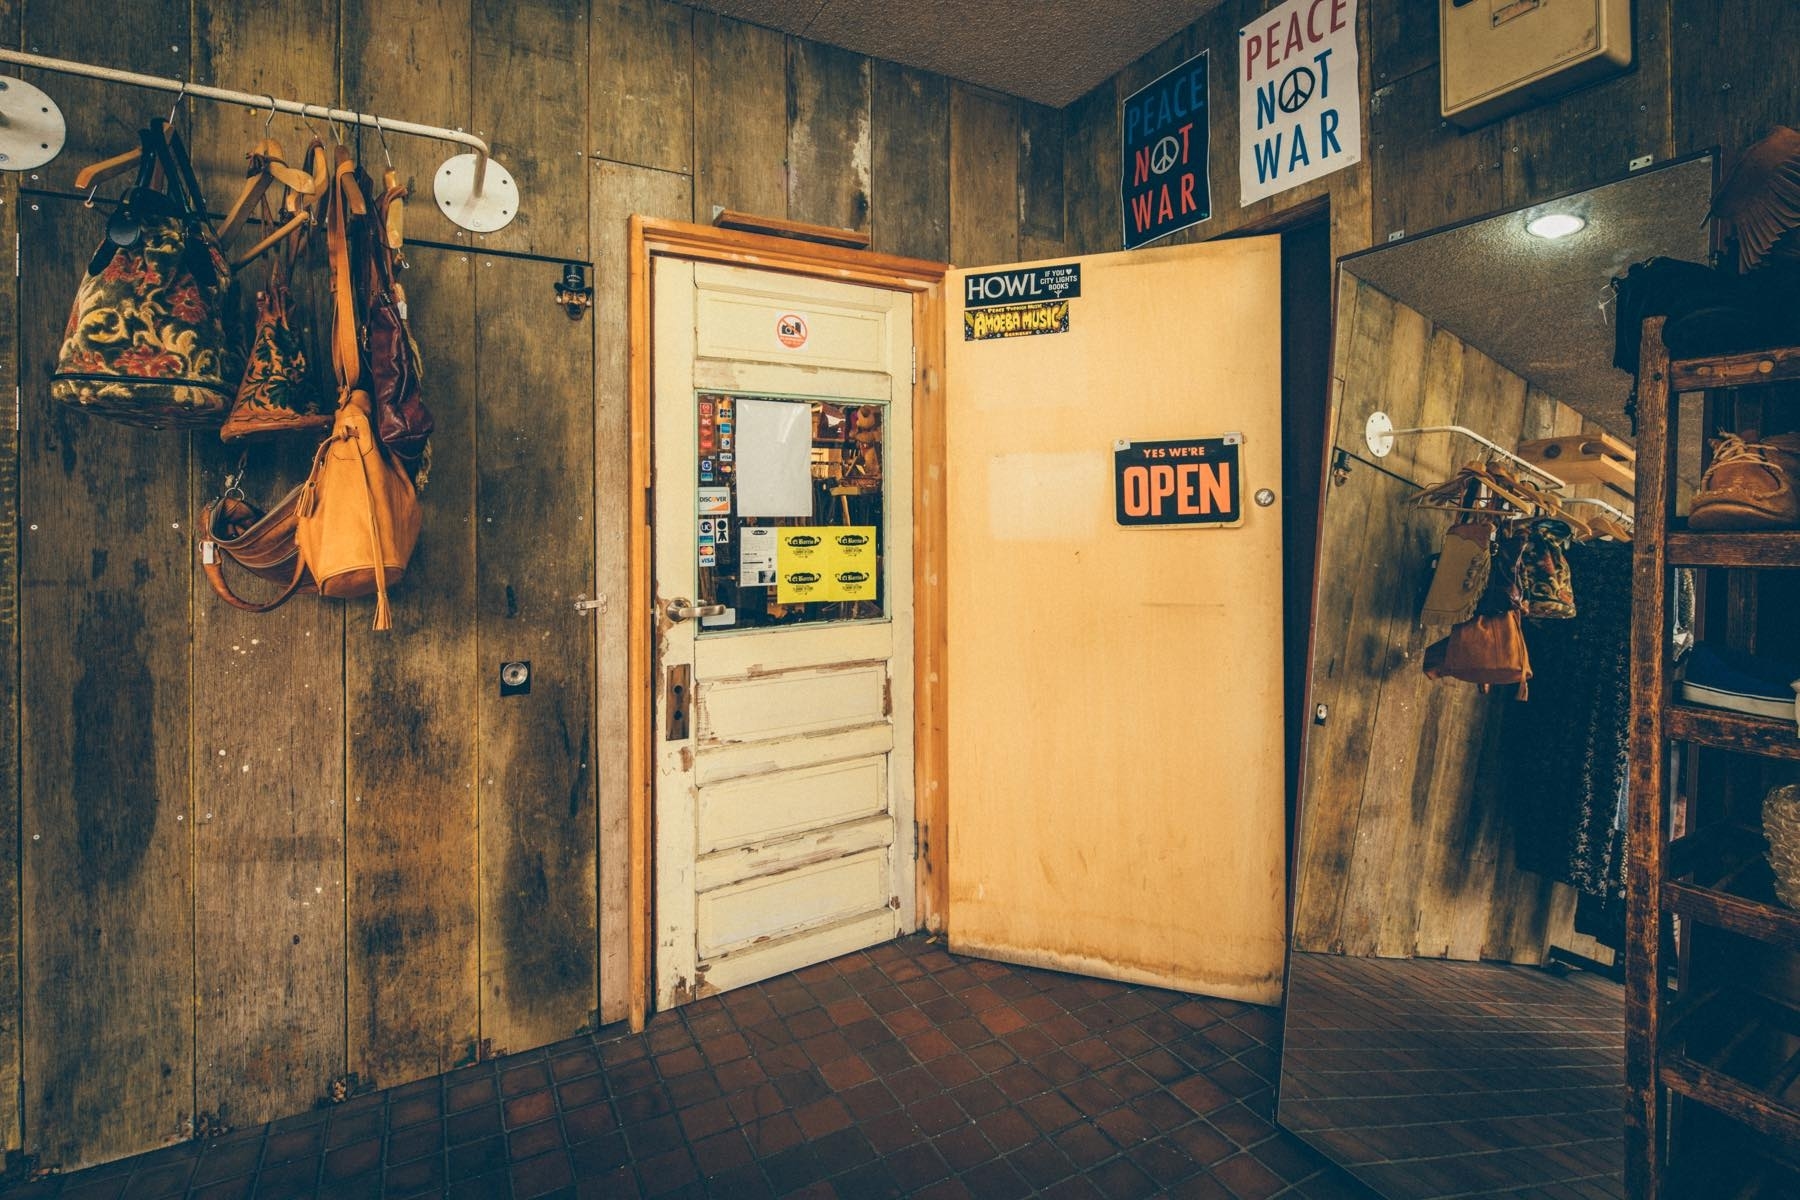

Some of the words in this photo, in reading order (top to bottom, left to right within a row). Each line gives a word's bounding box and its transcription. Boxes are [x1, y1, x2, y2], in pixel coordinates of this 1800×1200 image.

[1246, 0, 1348, 82] PEACE
[1128, 68, 1204, 145] PEACE
[1254, 109, 1342, 184] WAR
[1132, 173, 1197, 233] WAR
[967, 272, 1042, 300] HOWL
[1055, 275, 1078, 283] LIGHTS
[974, 312, 1021, 340] AMOEBA
[1022, 304, 1061, 330] MUSIC
[1143, 448, 1166, 458] YES
[1169, 446, 1205, 457] WE'RE
[1123, 462, 1231, 517] OPEN
